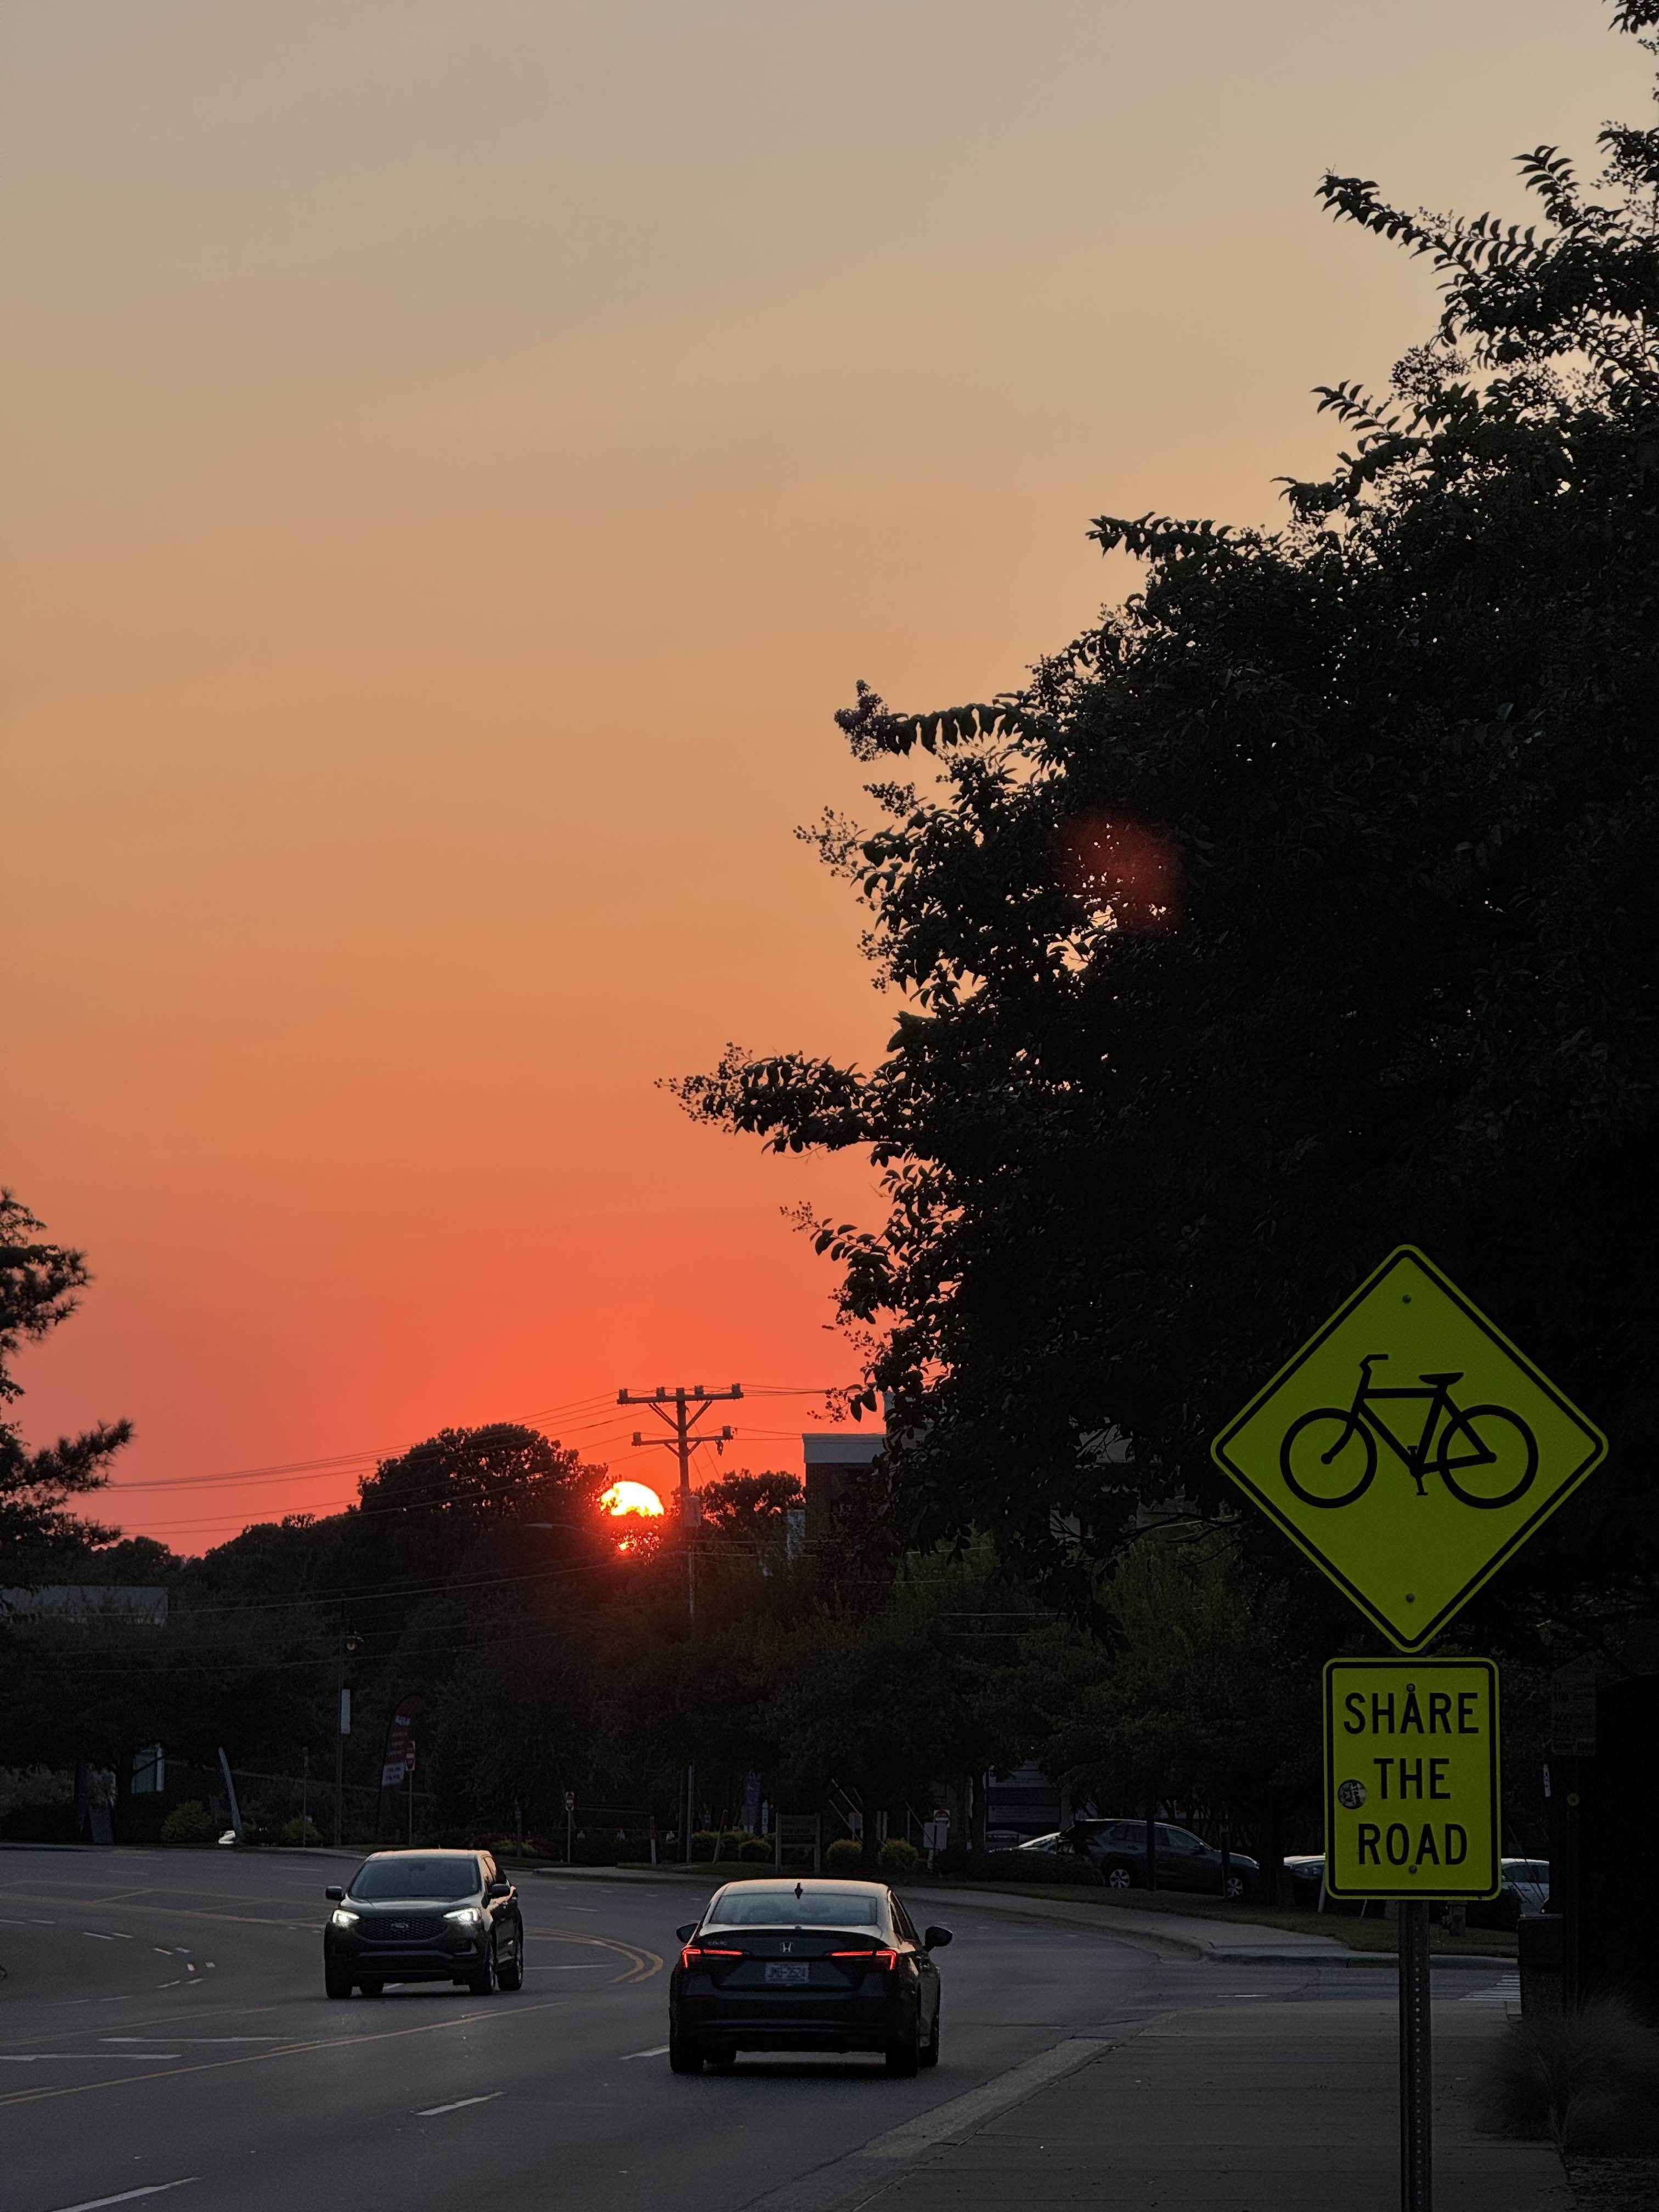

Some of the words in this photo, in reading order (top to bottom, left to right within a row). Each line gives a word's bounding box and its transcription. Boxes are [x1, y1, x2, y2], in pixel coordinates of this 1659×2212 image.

[1553, 1649, 1579, 1658] STOP
[1344, 1692, 1479, 1734] SHARE
[1373, 1758, 1451, 1799] THE
[1358, 1822, 1468, 1866] ROAD
